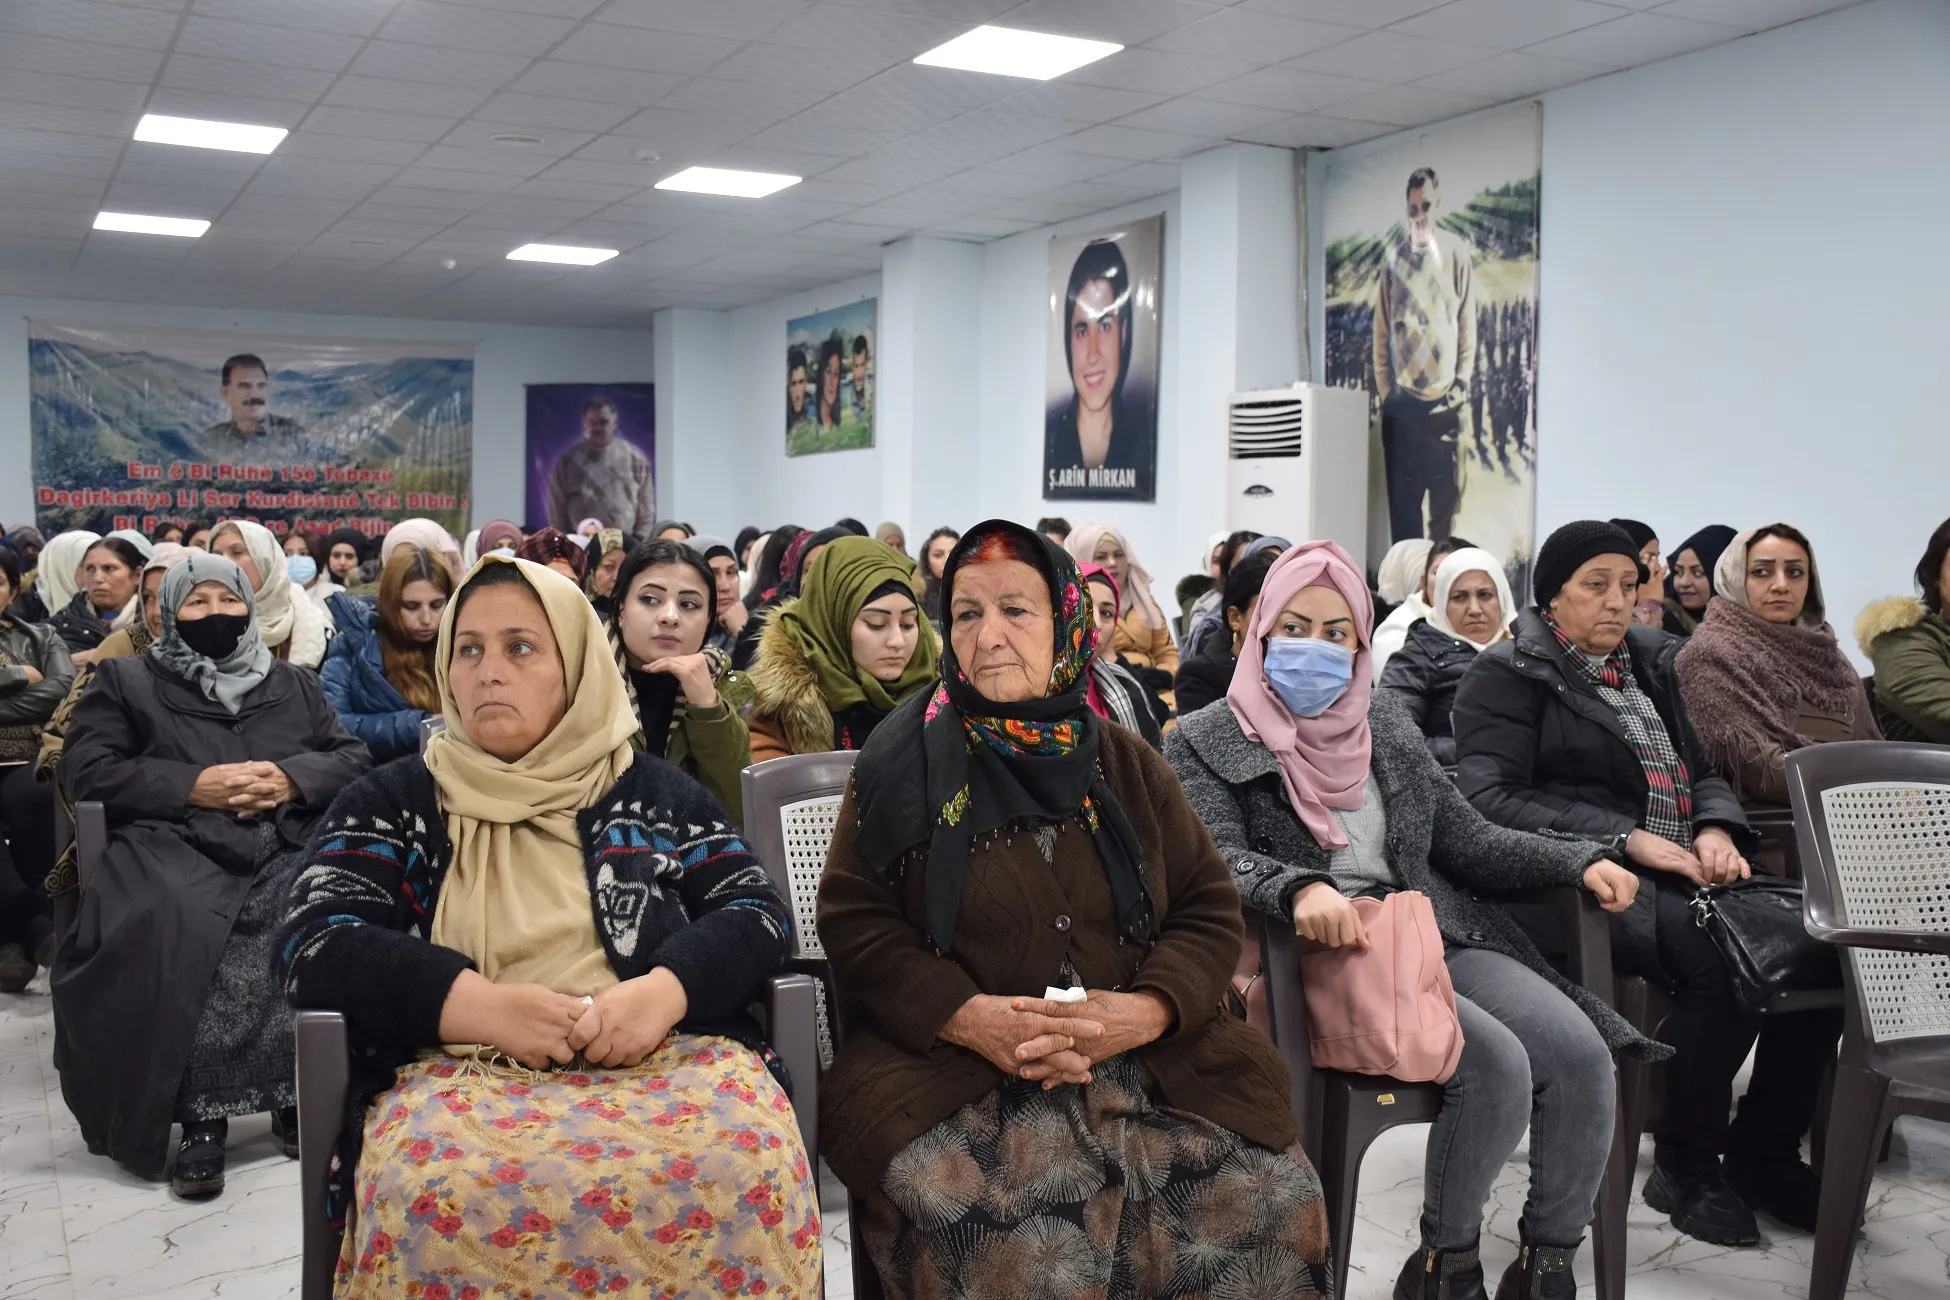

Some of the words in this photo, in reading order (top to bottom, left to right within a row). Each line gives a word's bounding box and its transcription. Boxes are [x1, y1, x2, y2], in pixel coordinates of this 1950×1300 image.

[1088, 464, 1136, 488] MİRKAN
[38, 487, 171, 511] Dagirkeriya
[204, 488, 240, 508] Ser
[366, 491, 400, 509] Tek
